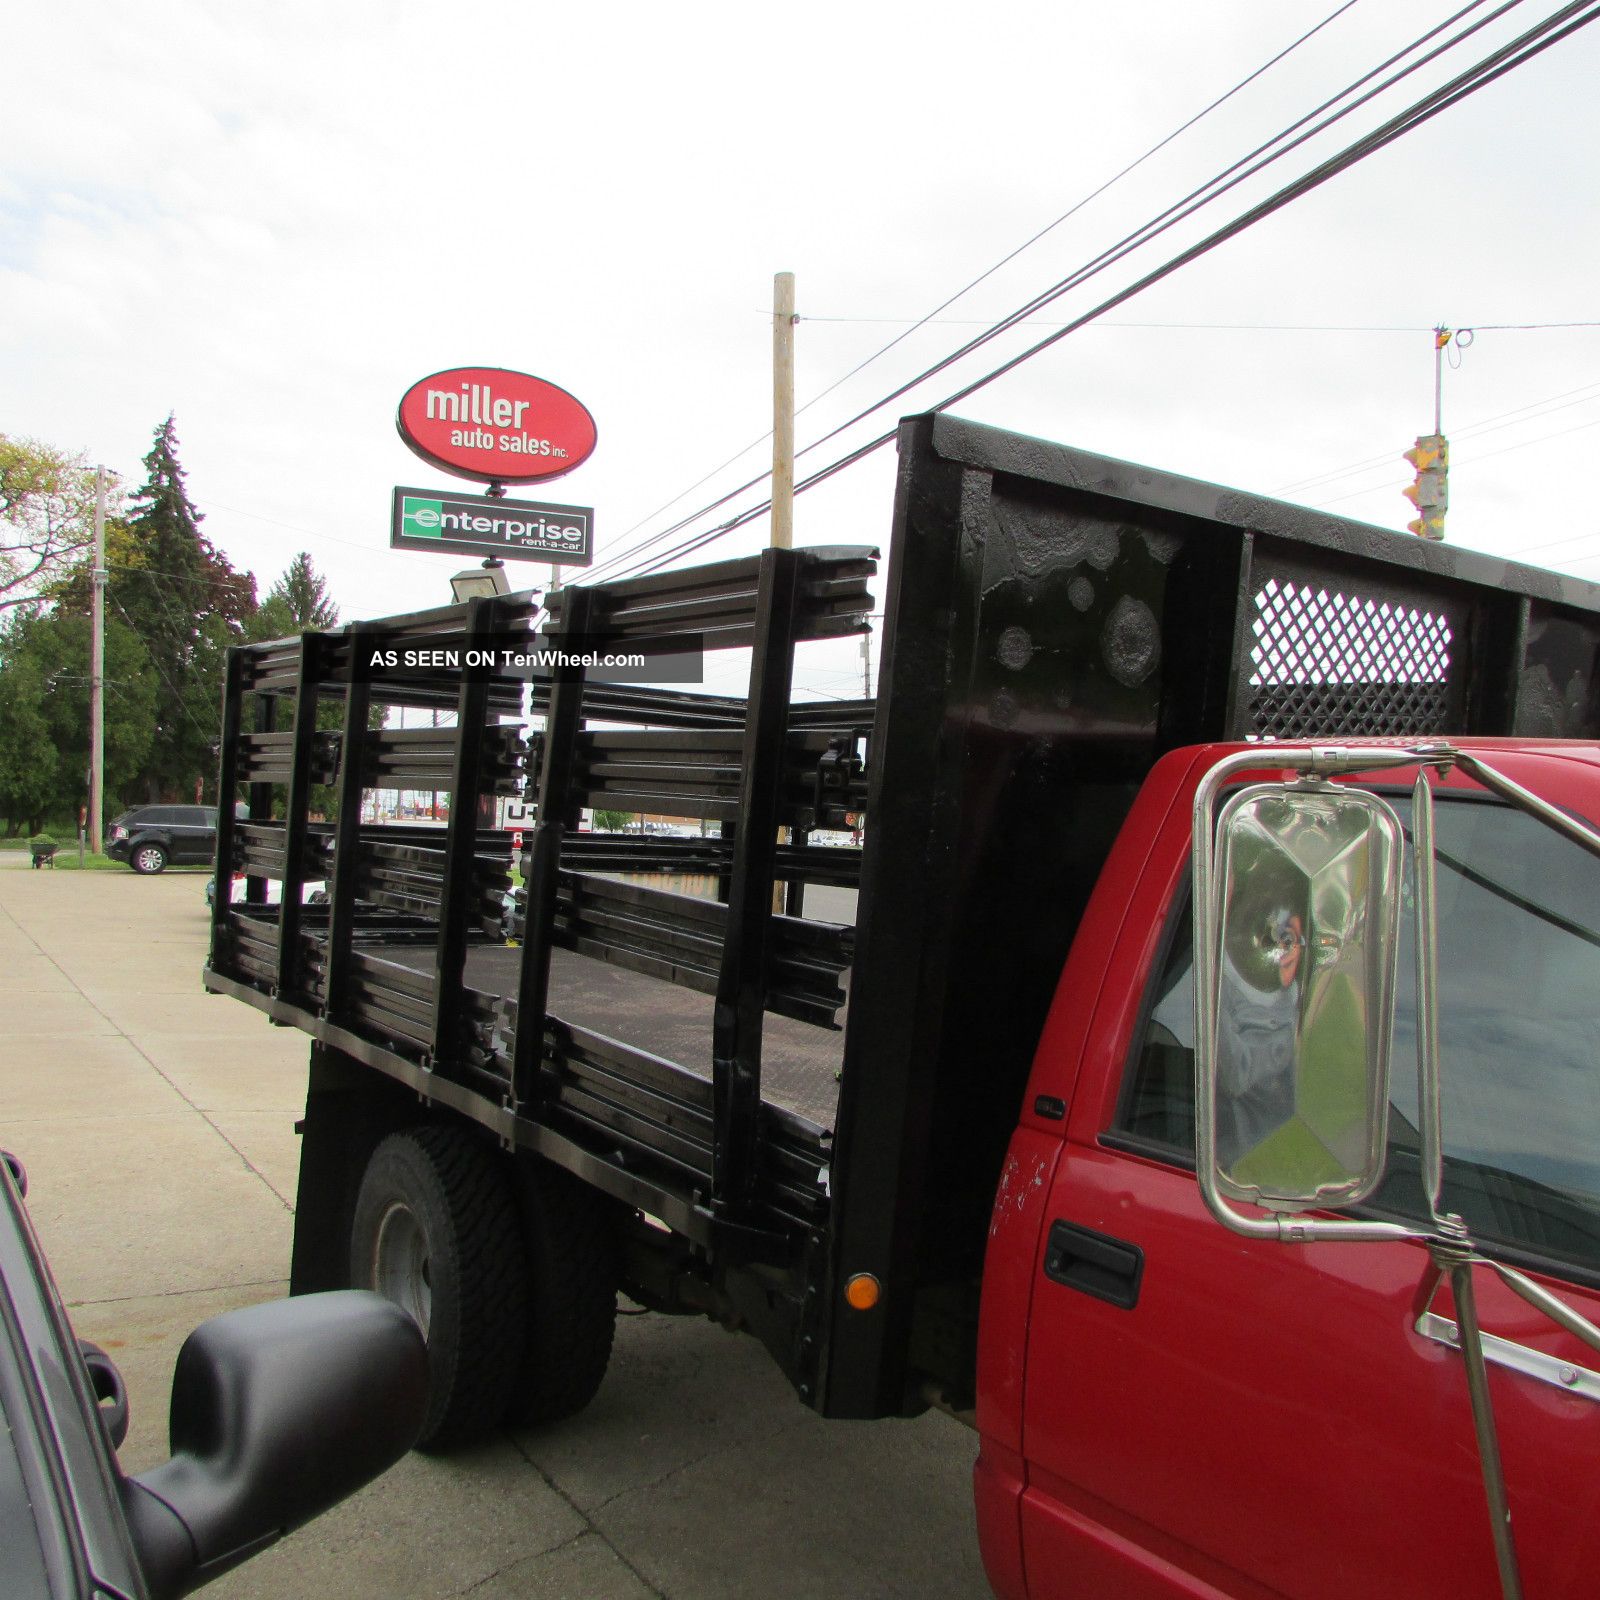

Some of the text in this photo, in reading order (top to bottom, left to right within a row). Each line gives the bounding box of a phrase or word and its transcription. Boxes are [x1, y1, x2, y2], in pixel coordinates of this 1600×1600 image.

[426, 383, 530, 429] miller
[451, 428, 569, 458] auto sales inc.
[414, 509, 582, 542] enterprise
[521, 537, 581, 551] rent-a-car
